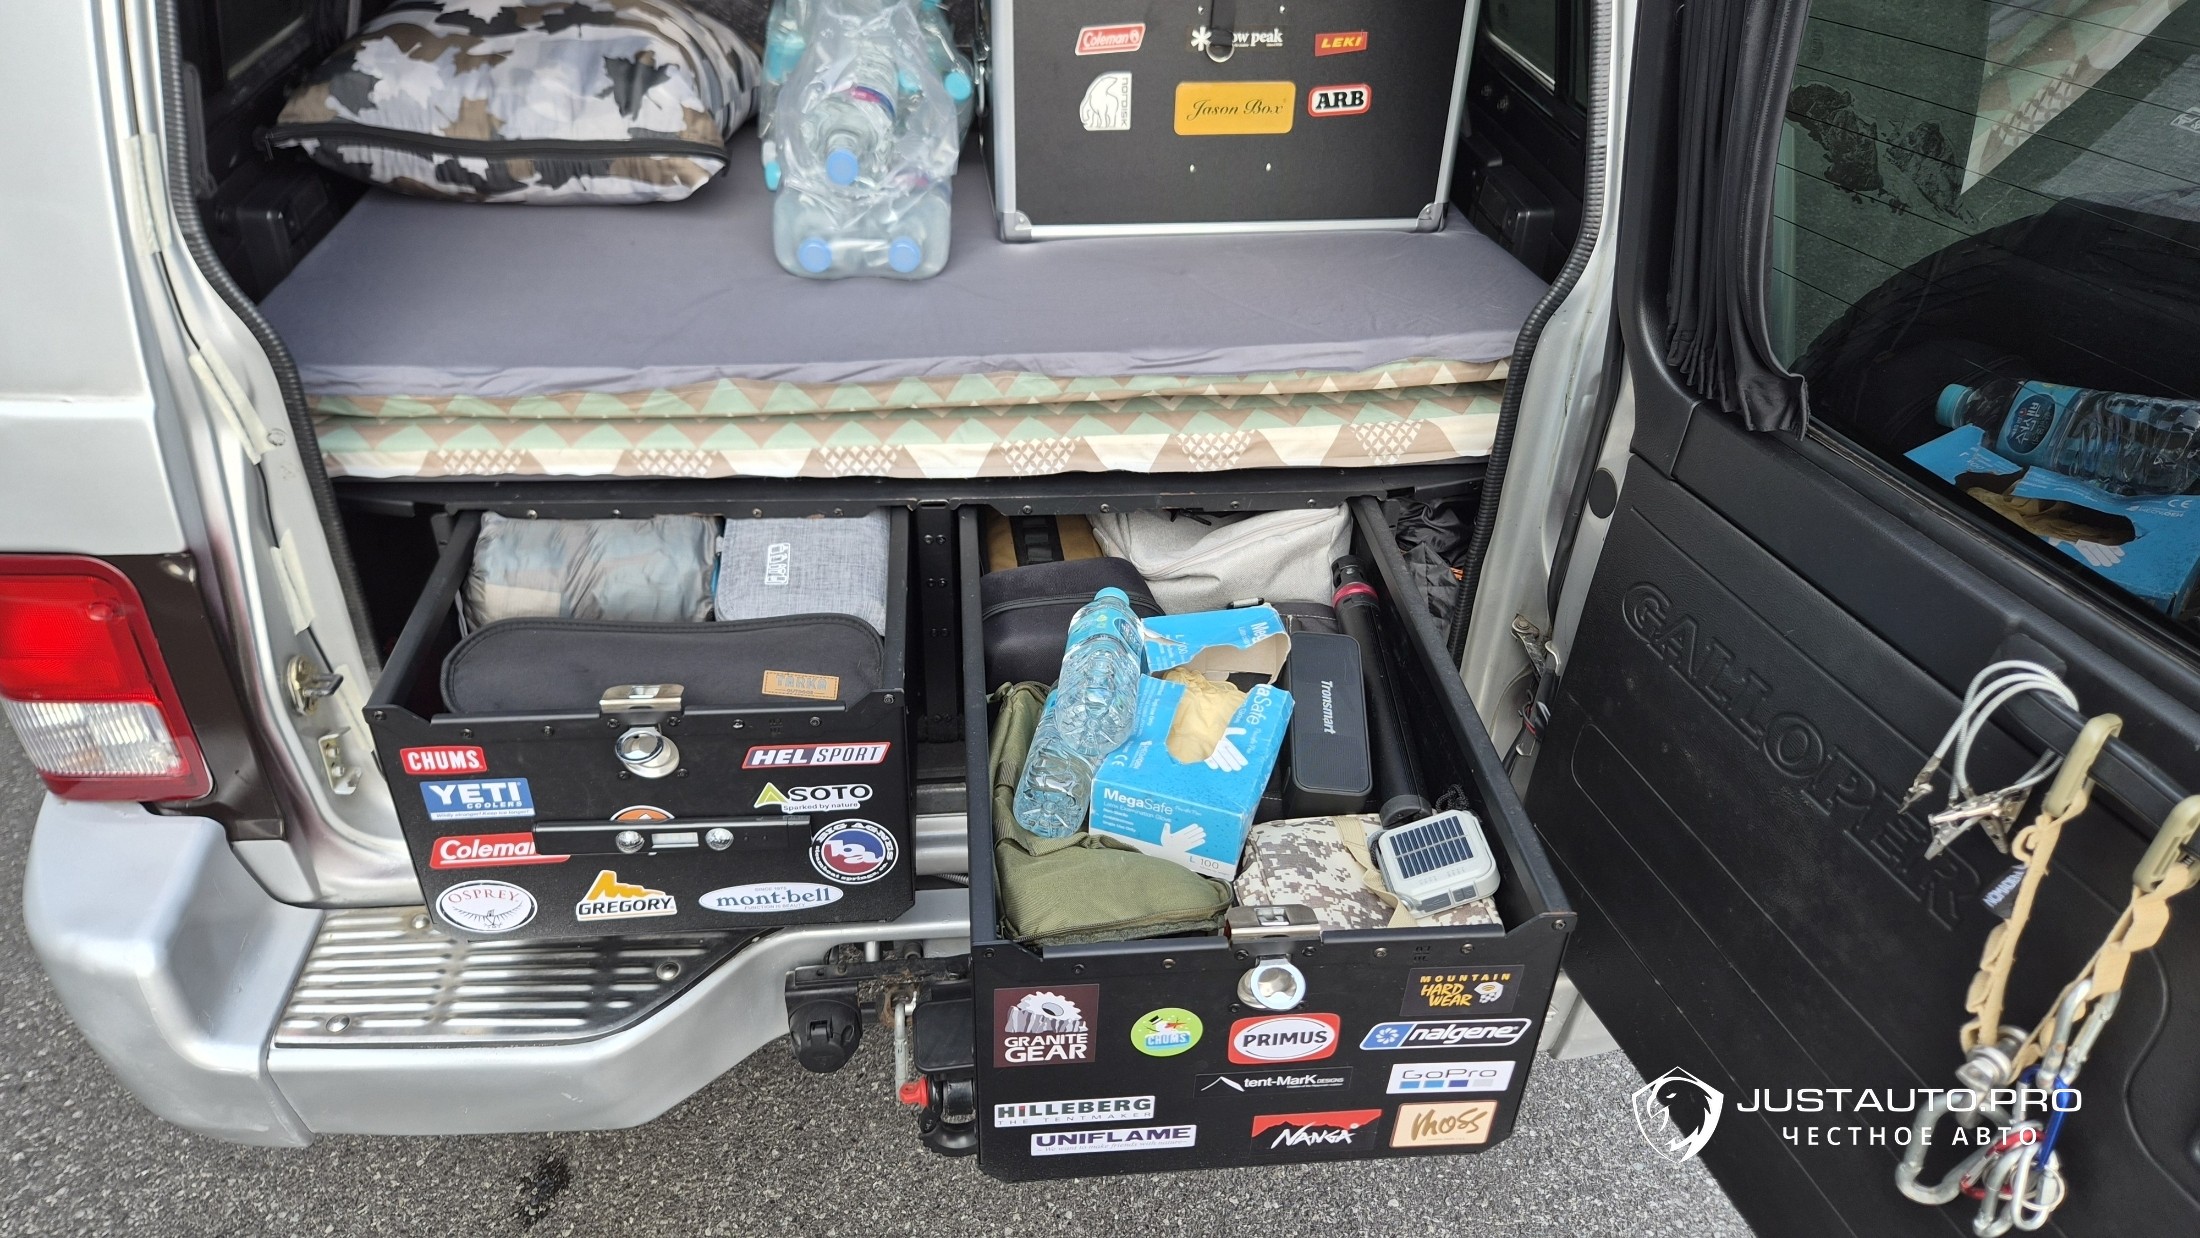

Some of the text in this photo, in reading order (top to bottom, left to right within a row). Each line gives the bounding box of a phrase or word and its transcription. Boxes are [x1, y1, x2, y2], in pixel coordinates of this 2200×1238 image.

[1083, 31, 1129, 48] Coleman
[1250, 28, 1283, 47] peak
[1321, 36, 1363, 49] LEKI
[1315, 90, 1364, 110] ARB
[1186, 99, 1283, 121] Jason Box
[1246, 685, 1272, 725] aSafe
[1321, 680, 1337, 735] Tronsmart
[407, 750, 480, 770] CHUMS
[1622, 581, 1983, 933] GALLOPER
[428, 782, 521, 805] YETI
[789, 785, 870, 802] SOTO
[1103, 787, 1173, 815] MegaSafe
[466, 801, 523, 809] COOLERS
[783, 804, 818, 812] Sparked
[816, 822, 893, 860] BIG AGNES
[1200, 858, 1219, 869] 100
[448, 888, 519, 904] OSPREY
[578, 897, 673, 915] GREGORY
[1420, 973, 1511, 983] MOUNTAIN
[1420, 983, 1464, 996] HARD
[1429, 994, 1472, 1007] WEAR
[1004, 1033, 1088, 1048] GRANITE
[1147, 1033, 1186, 1046] CHUMS
[1242, 1030, 1328, 1047] PRIMUS
[1409, 1024, 1516, 1044] nalgene
[1004, 1044, 1088, 1063] GEAR
[1402, 1069, 1498, 1080] GoPro
[1044, 1112, 1151, 1123] TENTMAKER
[1036, 1127, 1191, 1147] UNIFLAME
[1270, 1122, 1356, 1149] NANGA
